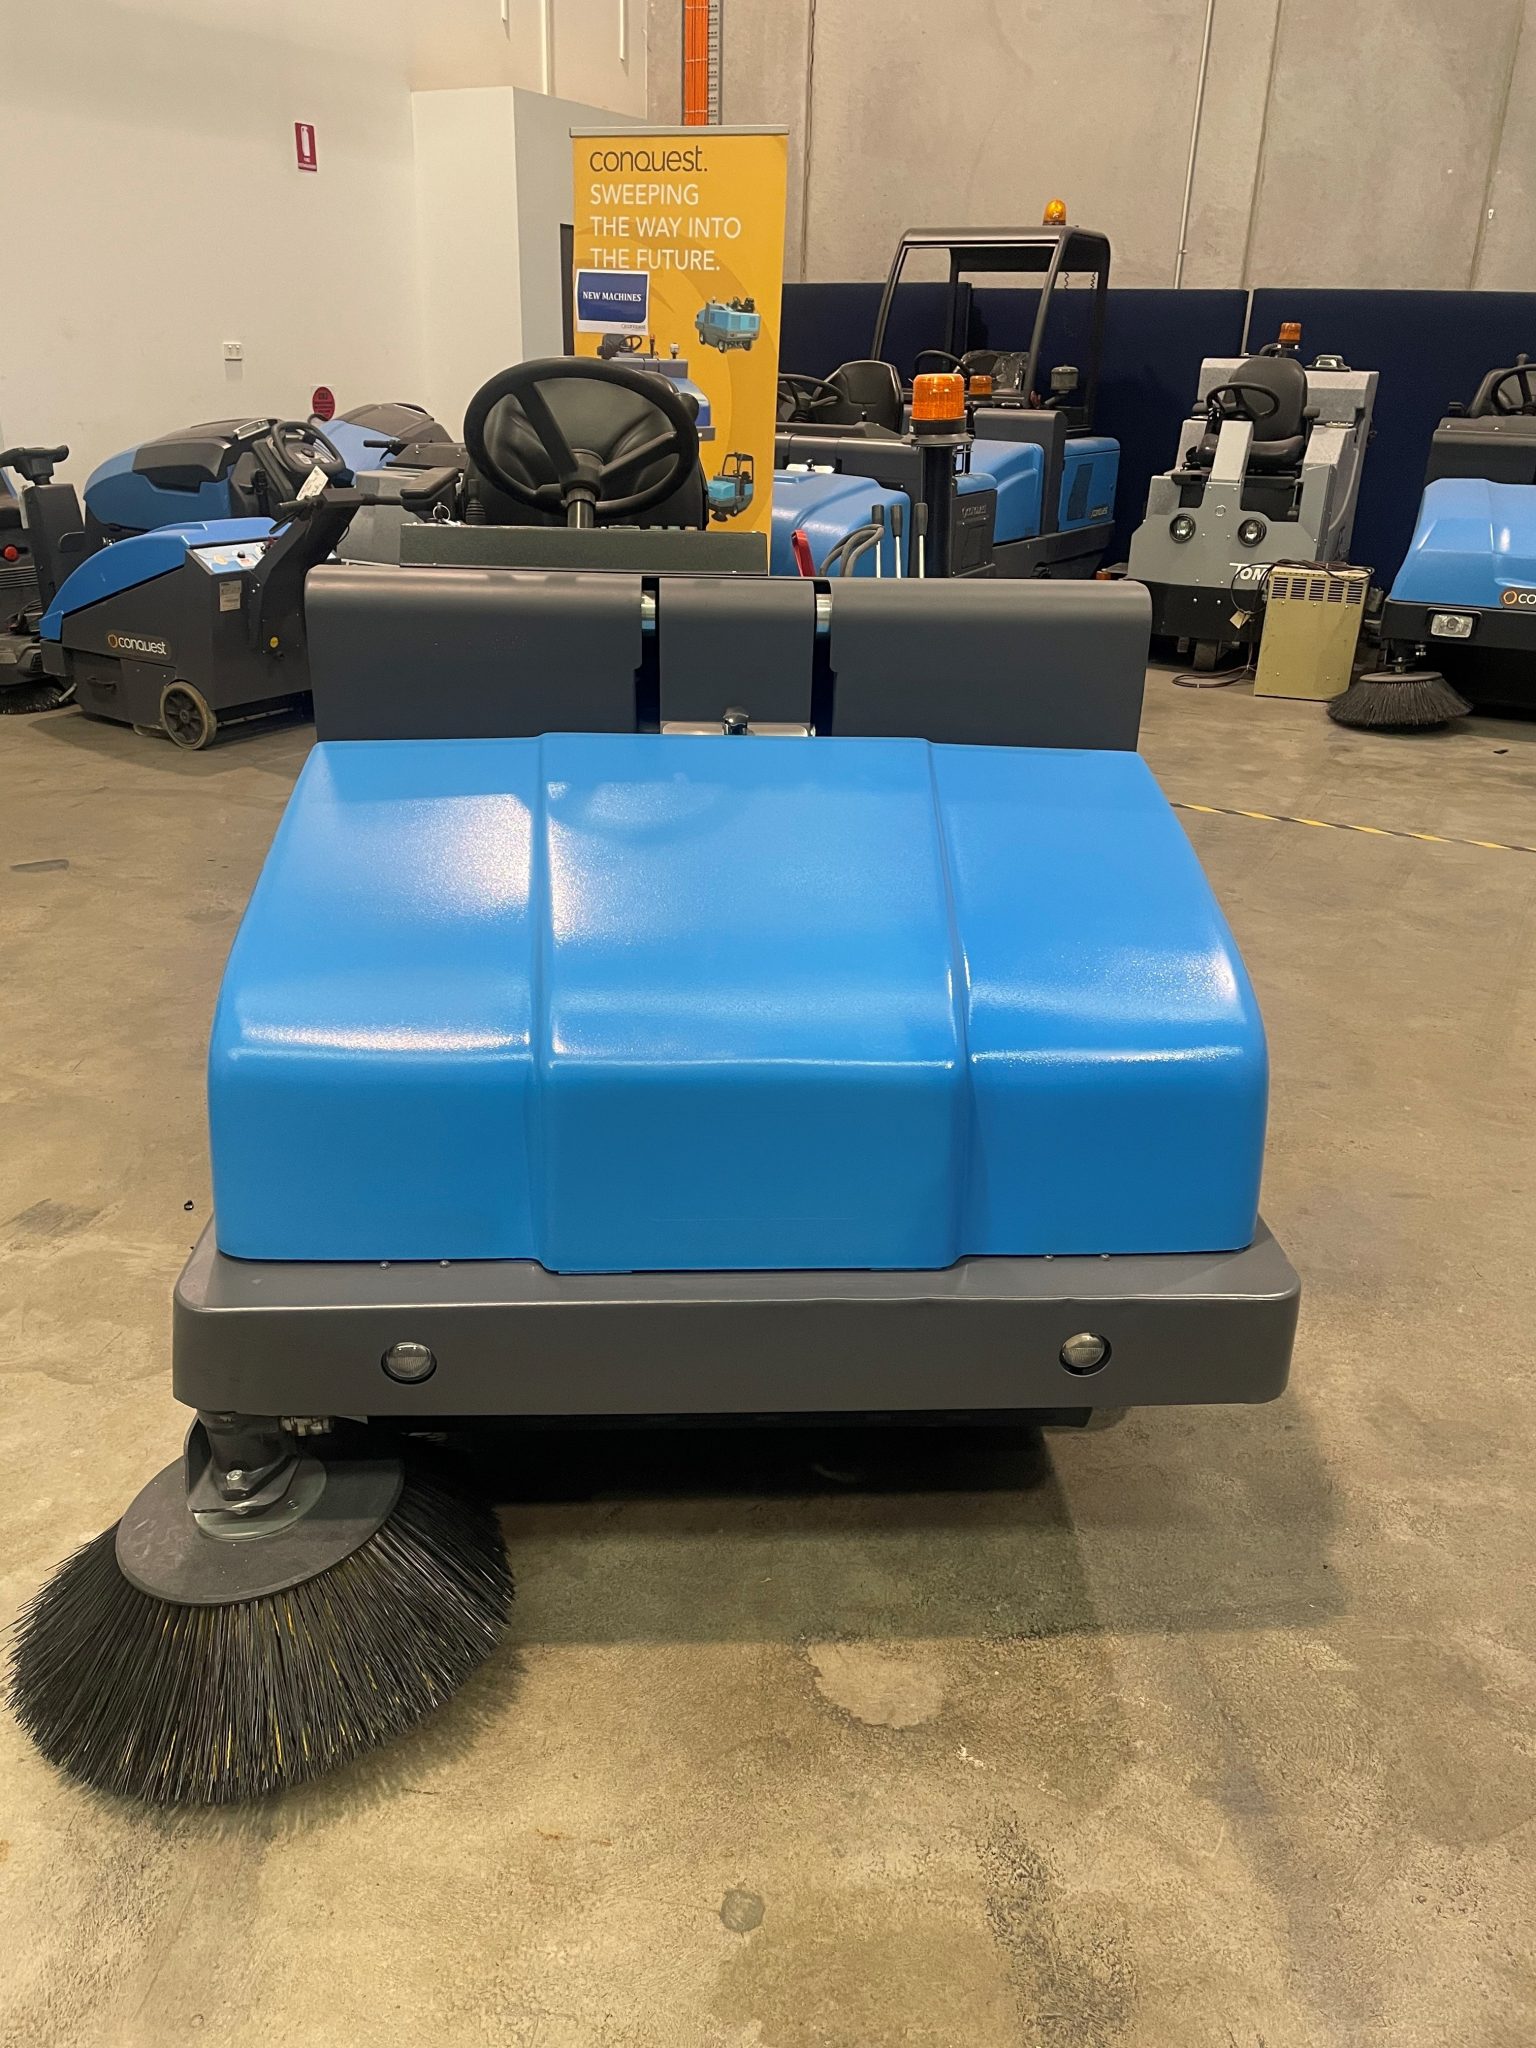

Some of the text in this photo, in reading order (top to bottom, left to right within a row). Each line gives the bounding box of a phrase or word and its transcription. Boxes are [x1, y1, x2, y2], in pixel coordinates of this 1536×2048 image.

[590, 183, 699, 206] SWEEPING
[590, 216, 742, 239] THE WAY INTO
[590, 248, 720, 271] THE FUTURE.
[582, 290, 642, 302] NEW MACHINES
[118, 637, 167, 655] conquest
